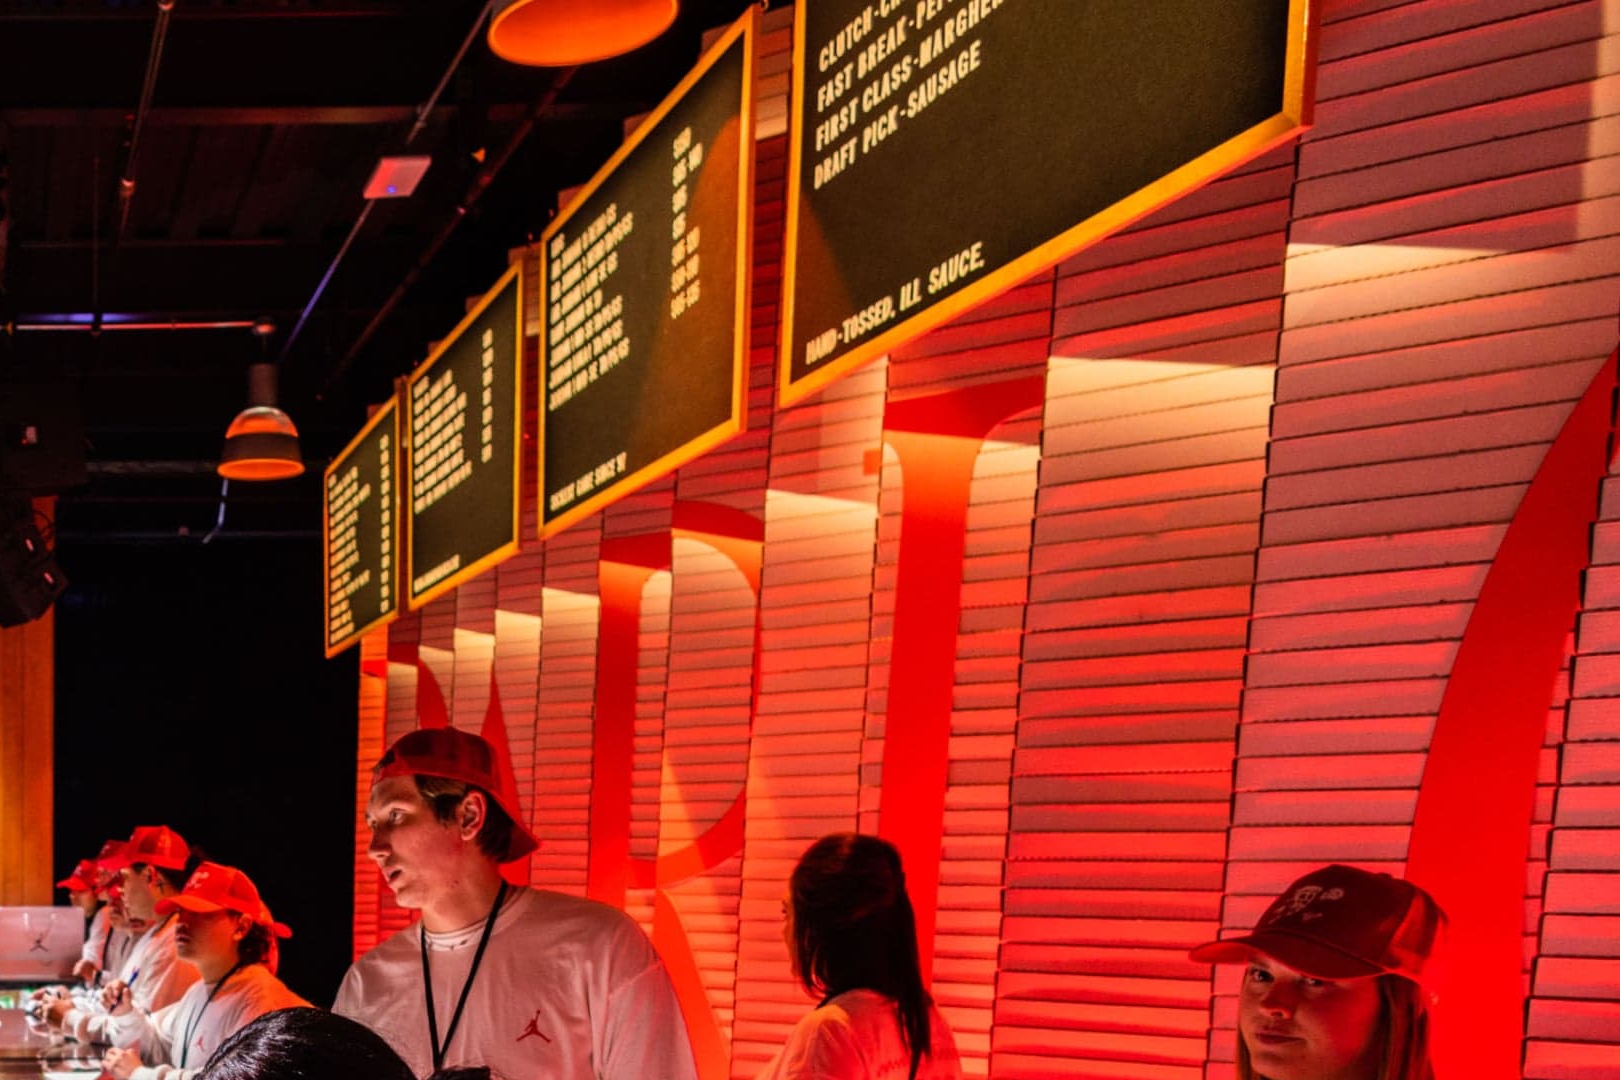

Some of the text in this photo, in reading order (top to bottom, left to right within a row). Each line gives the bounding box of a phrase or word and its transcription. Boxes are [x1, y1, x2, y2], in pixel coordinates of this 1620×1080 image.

[817, 61, 854, 113] FAST
[816, 96, 859, 152] FIRST
[814, 136, 858, 190] DRAFT
[898, 276, 923, 312] ILL
[926, 240, 986, 295] SAUCE.
